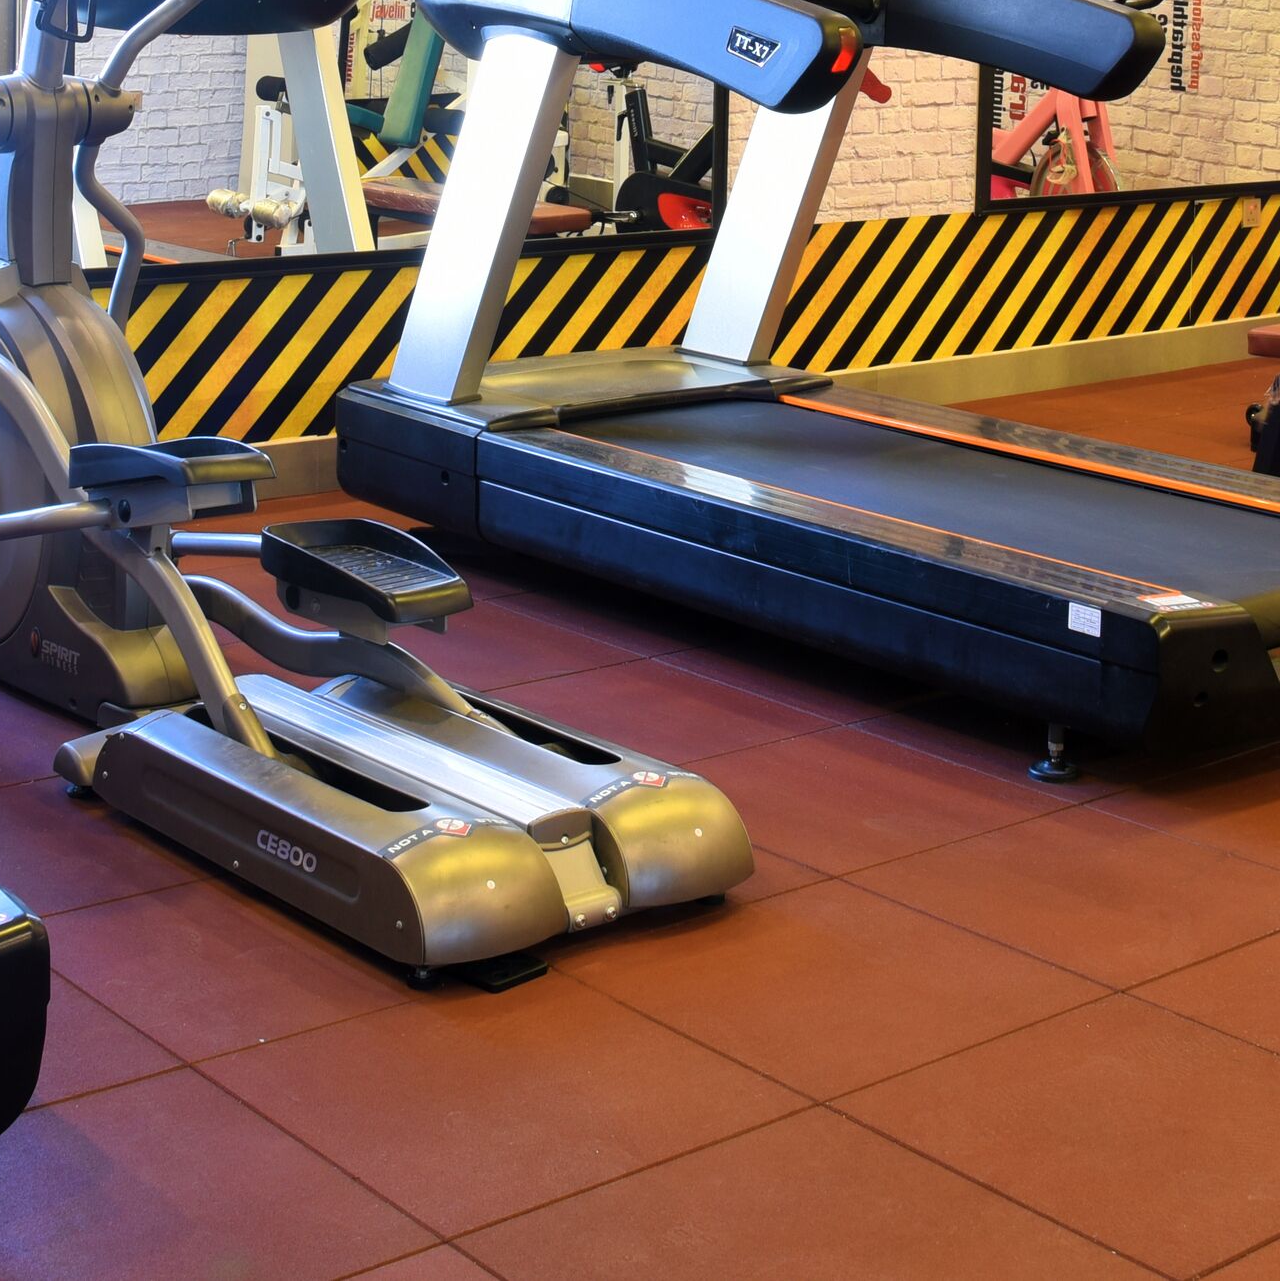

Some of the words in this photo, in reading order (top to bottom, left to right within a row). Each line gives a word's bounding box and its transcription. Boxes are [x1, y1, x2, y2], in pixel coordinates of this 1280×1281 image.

[735, 33, 770, 59] TT-X7
[41, 639, 81, 666] SPIRIT
[589, 784, 619, 804] NOT
[621, 779, 632, 788] A
[256, 829, 318, 874] CE800
[387, 833, 420, 855] NOT
[421, 828, 435, 838] A
